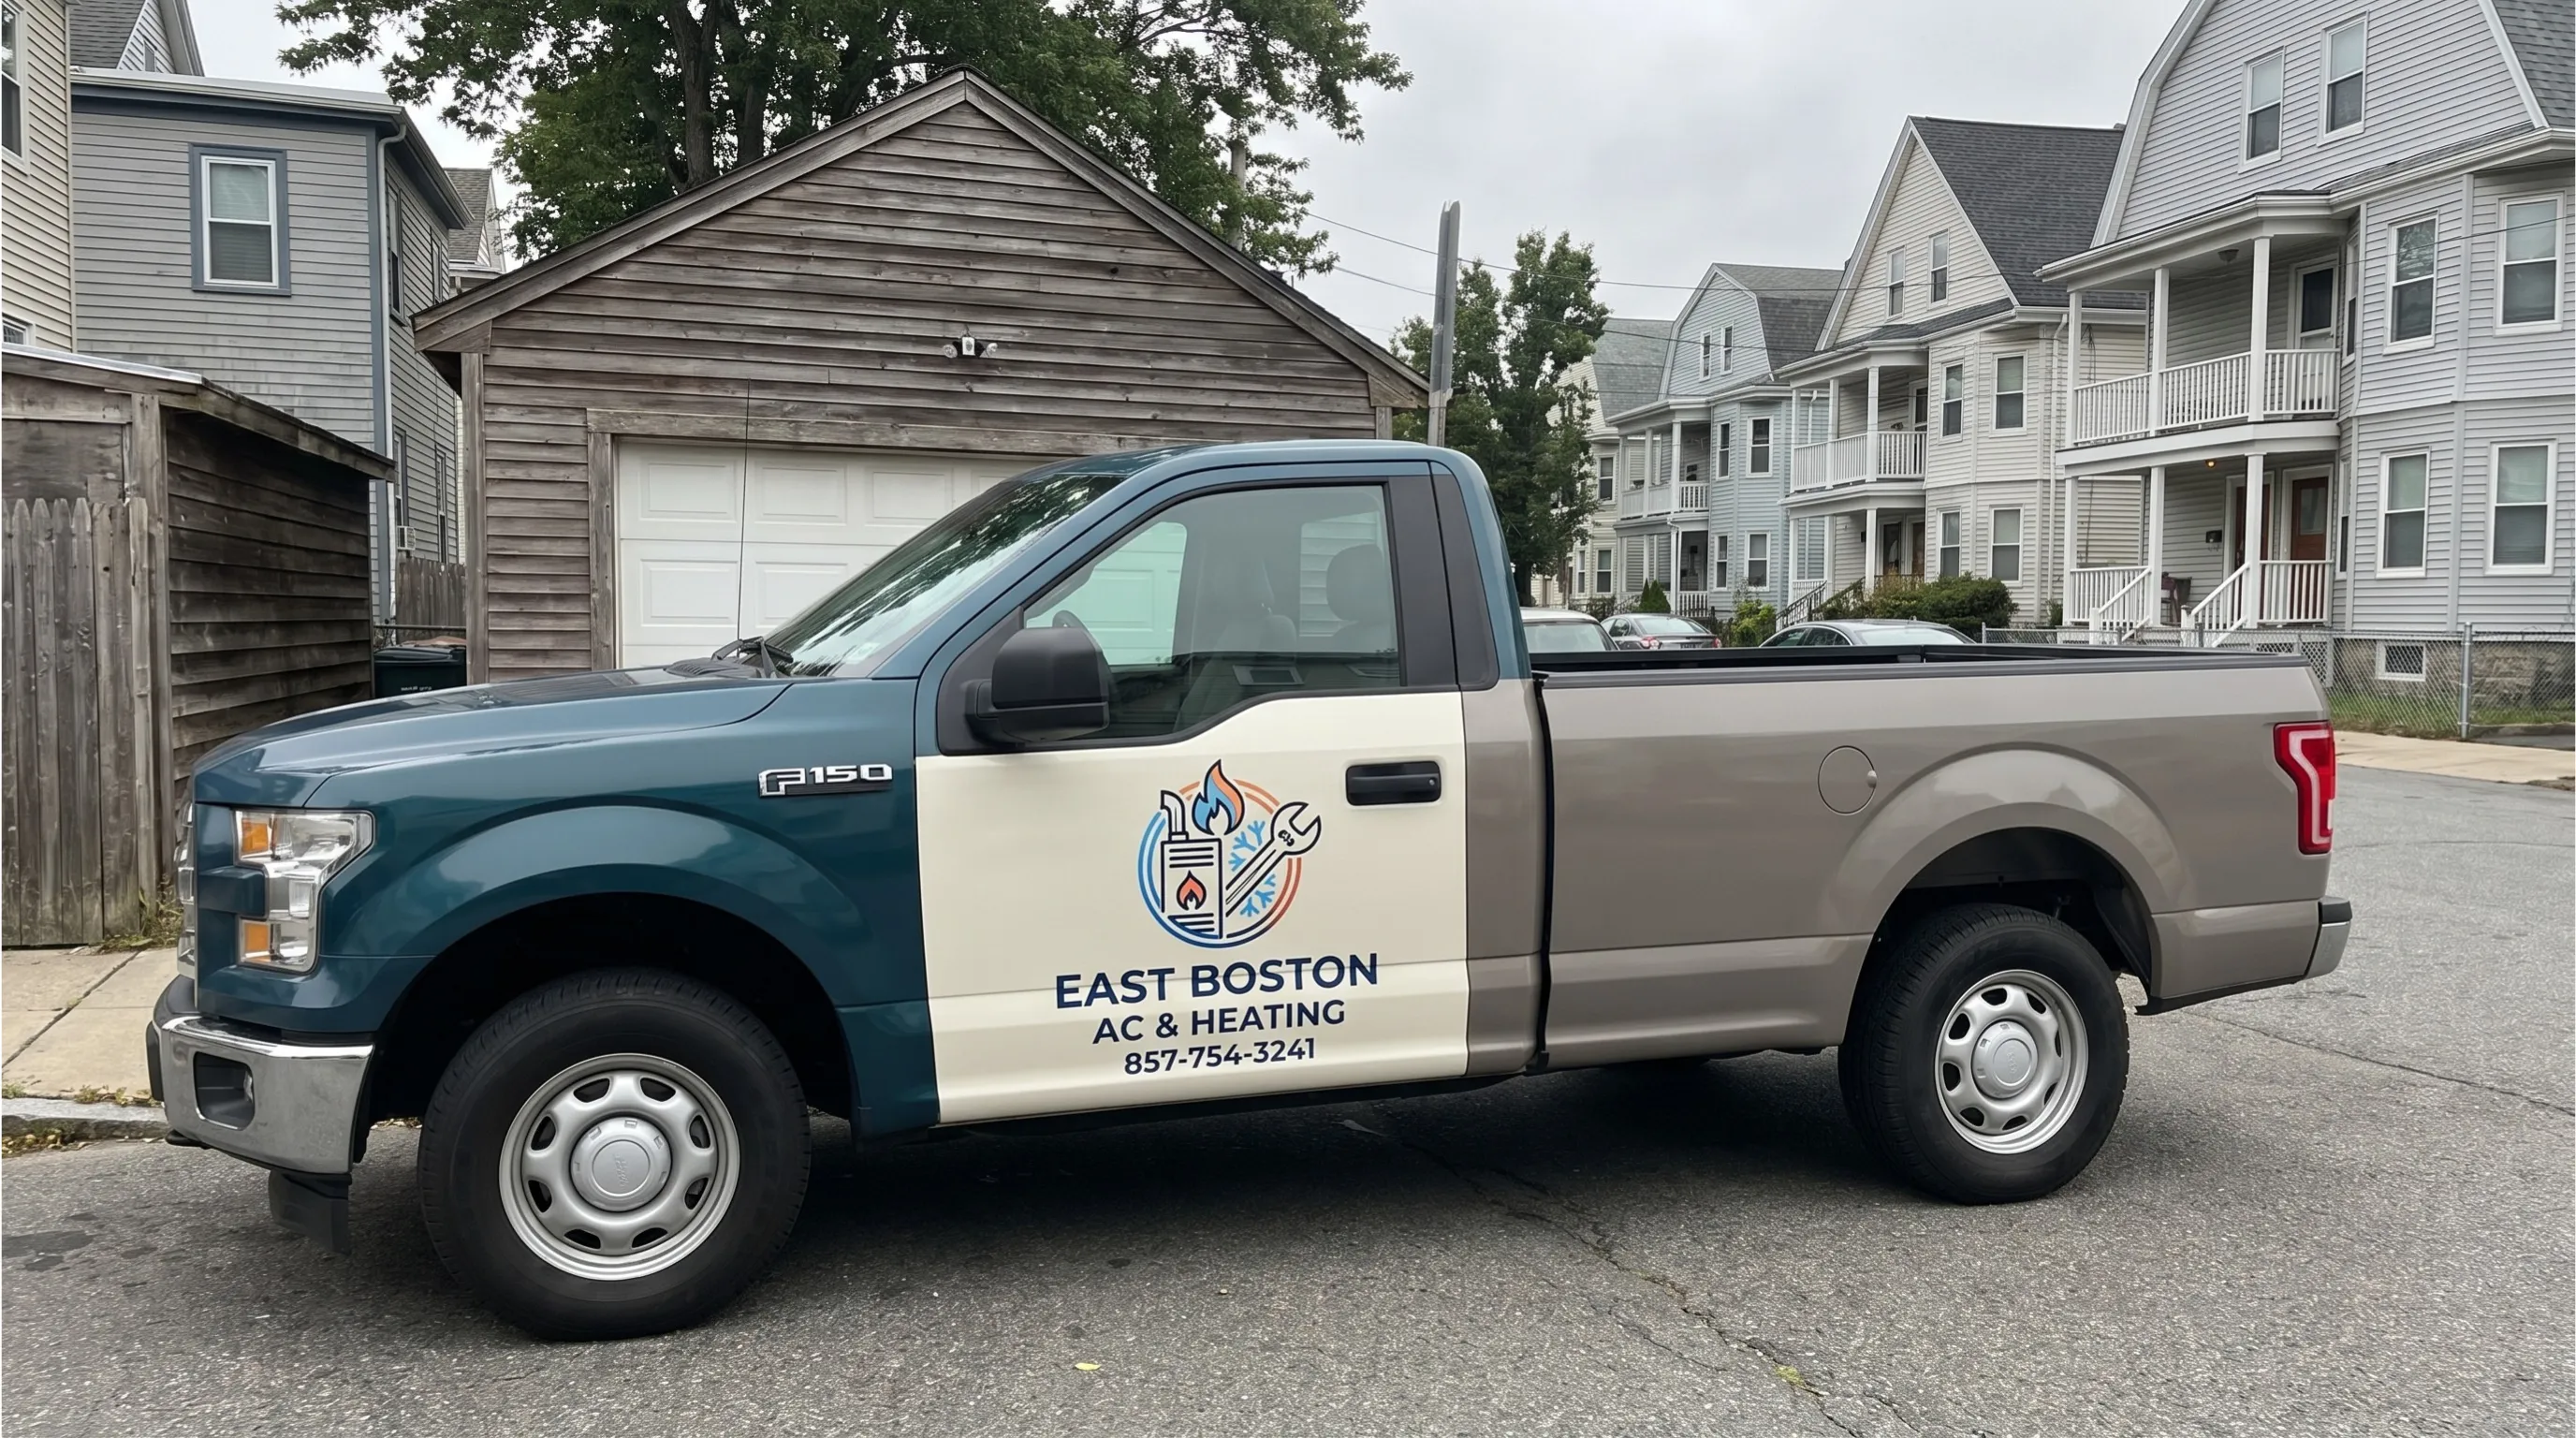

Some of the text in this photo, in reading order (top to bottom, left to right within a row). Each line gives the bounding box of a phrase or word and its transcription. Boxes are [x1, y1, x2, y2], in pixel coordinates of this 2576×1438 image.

[1056, 952, 1378, 1009] EAST BOSTON
[1092, 999, 1345, 1045] AC & HEATING
[1124, 1037, 1315, 1075] 857-754-3241
